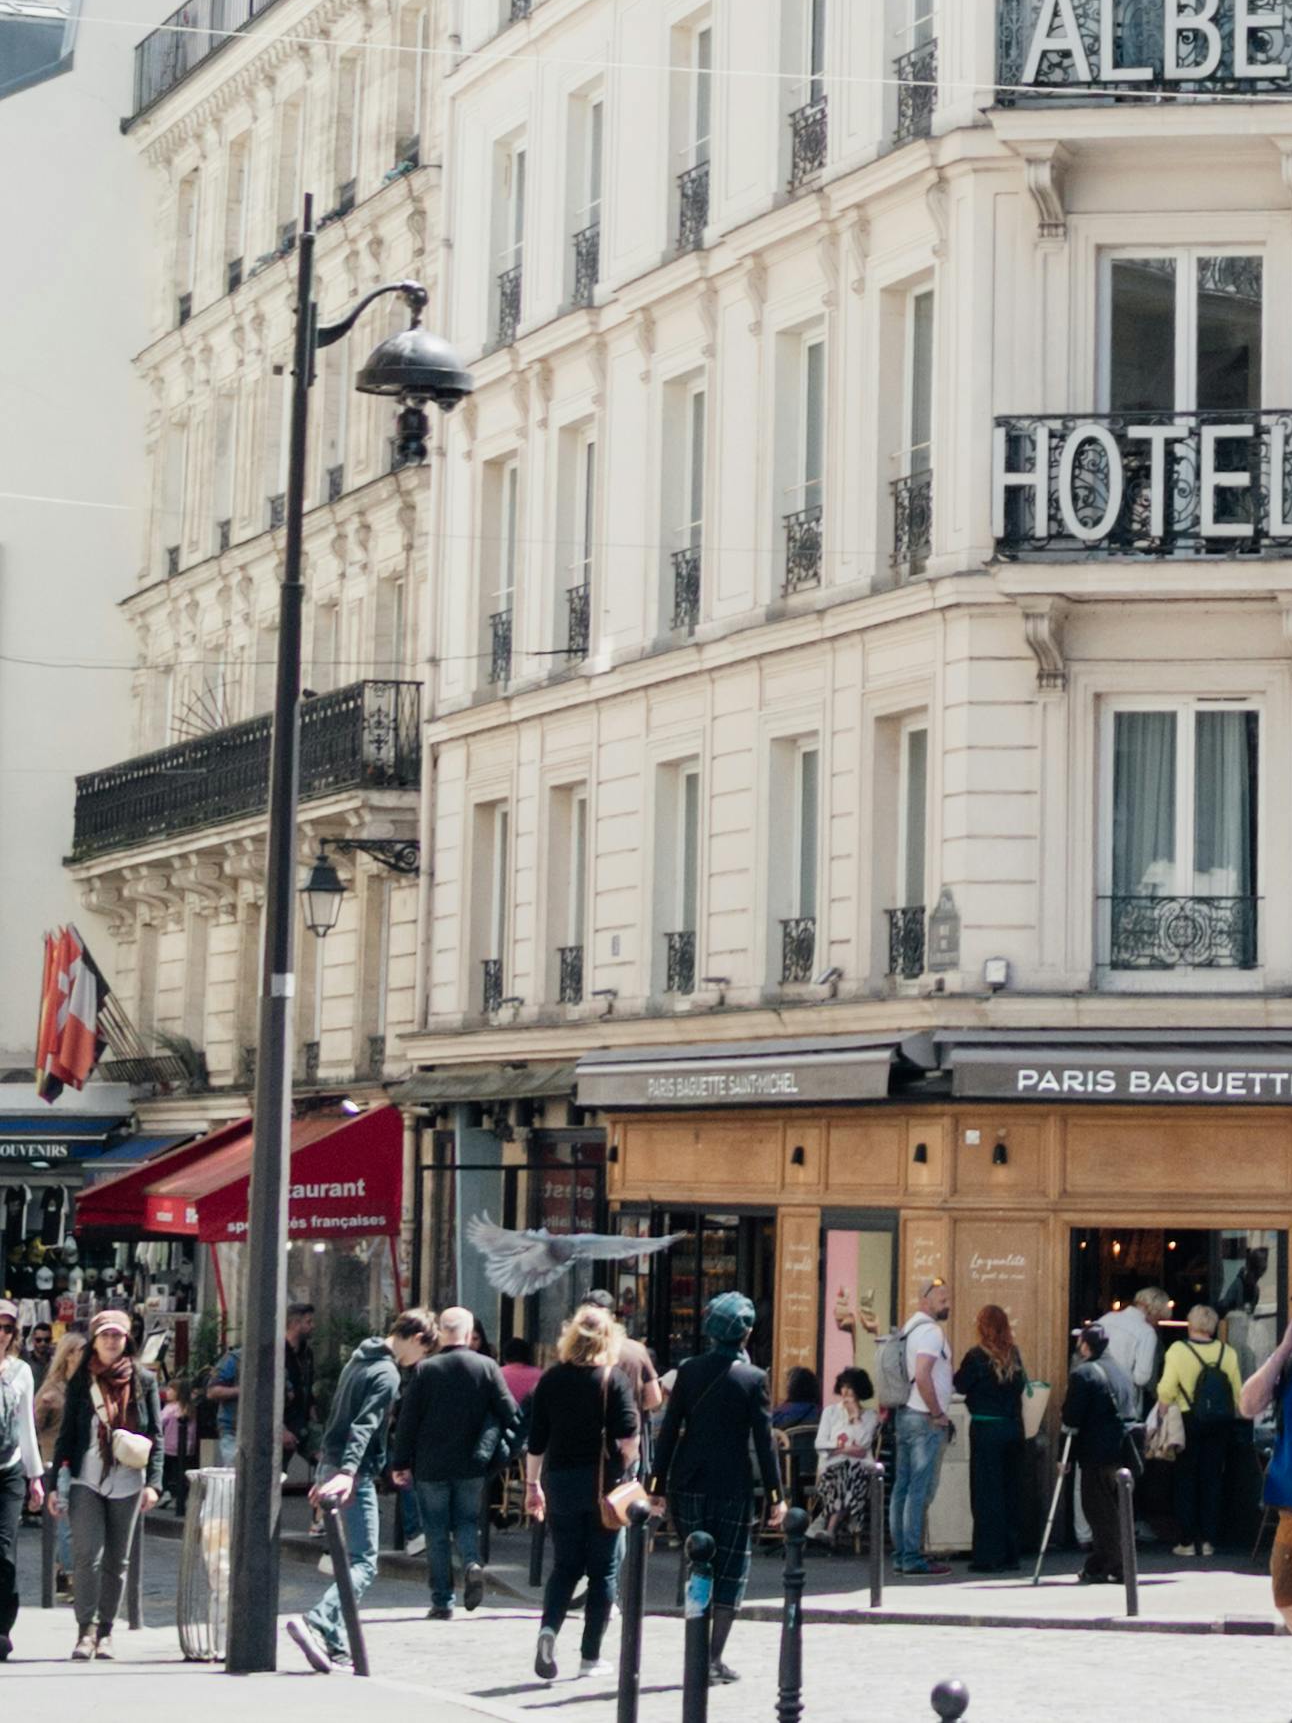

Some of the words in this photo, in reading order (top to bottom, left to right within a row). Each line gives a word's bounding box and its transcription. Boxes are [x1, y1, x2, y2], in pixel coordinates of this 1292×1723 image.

[648, 1077, 675, 1097] PARIS
[676, 1074, 726, 1096] BAGUETTE
[1017, 1069, 1117, 1093] PARIS
[311, 1213, 387, 1230] françaises
